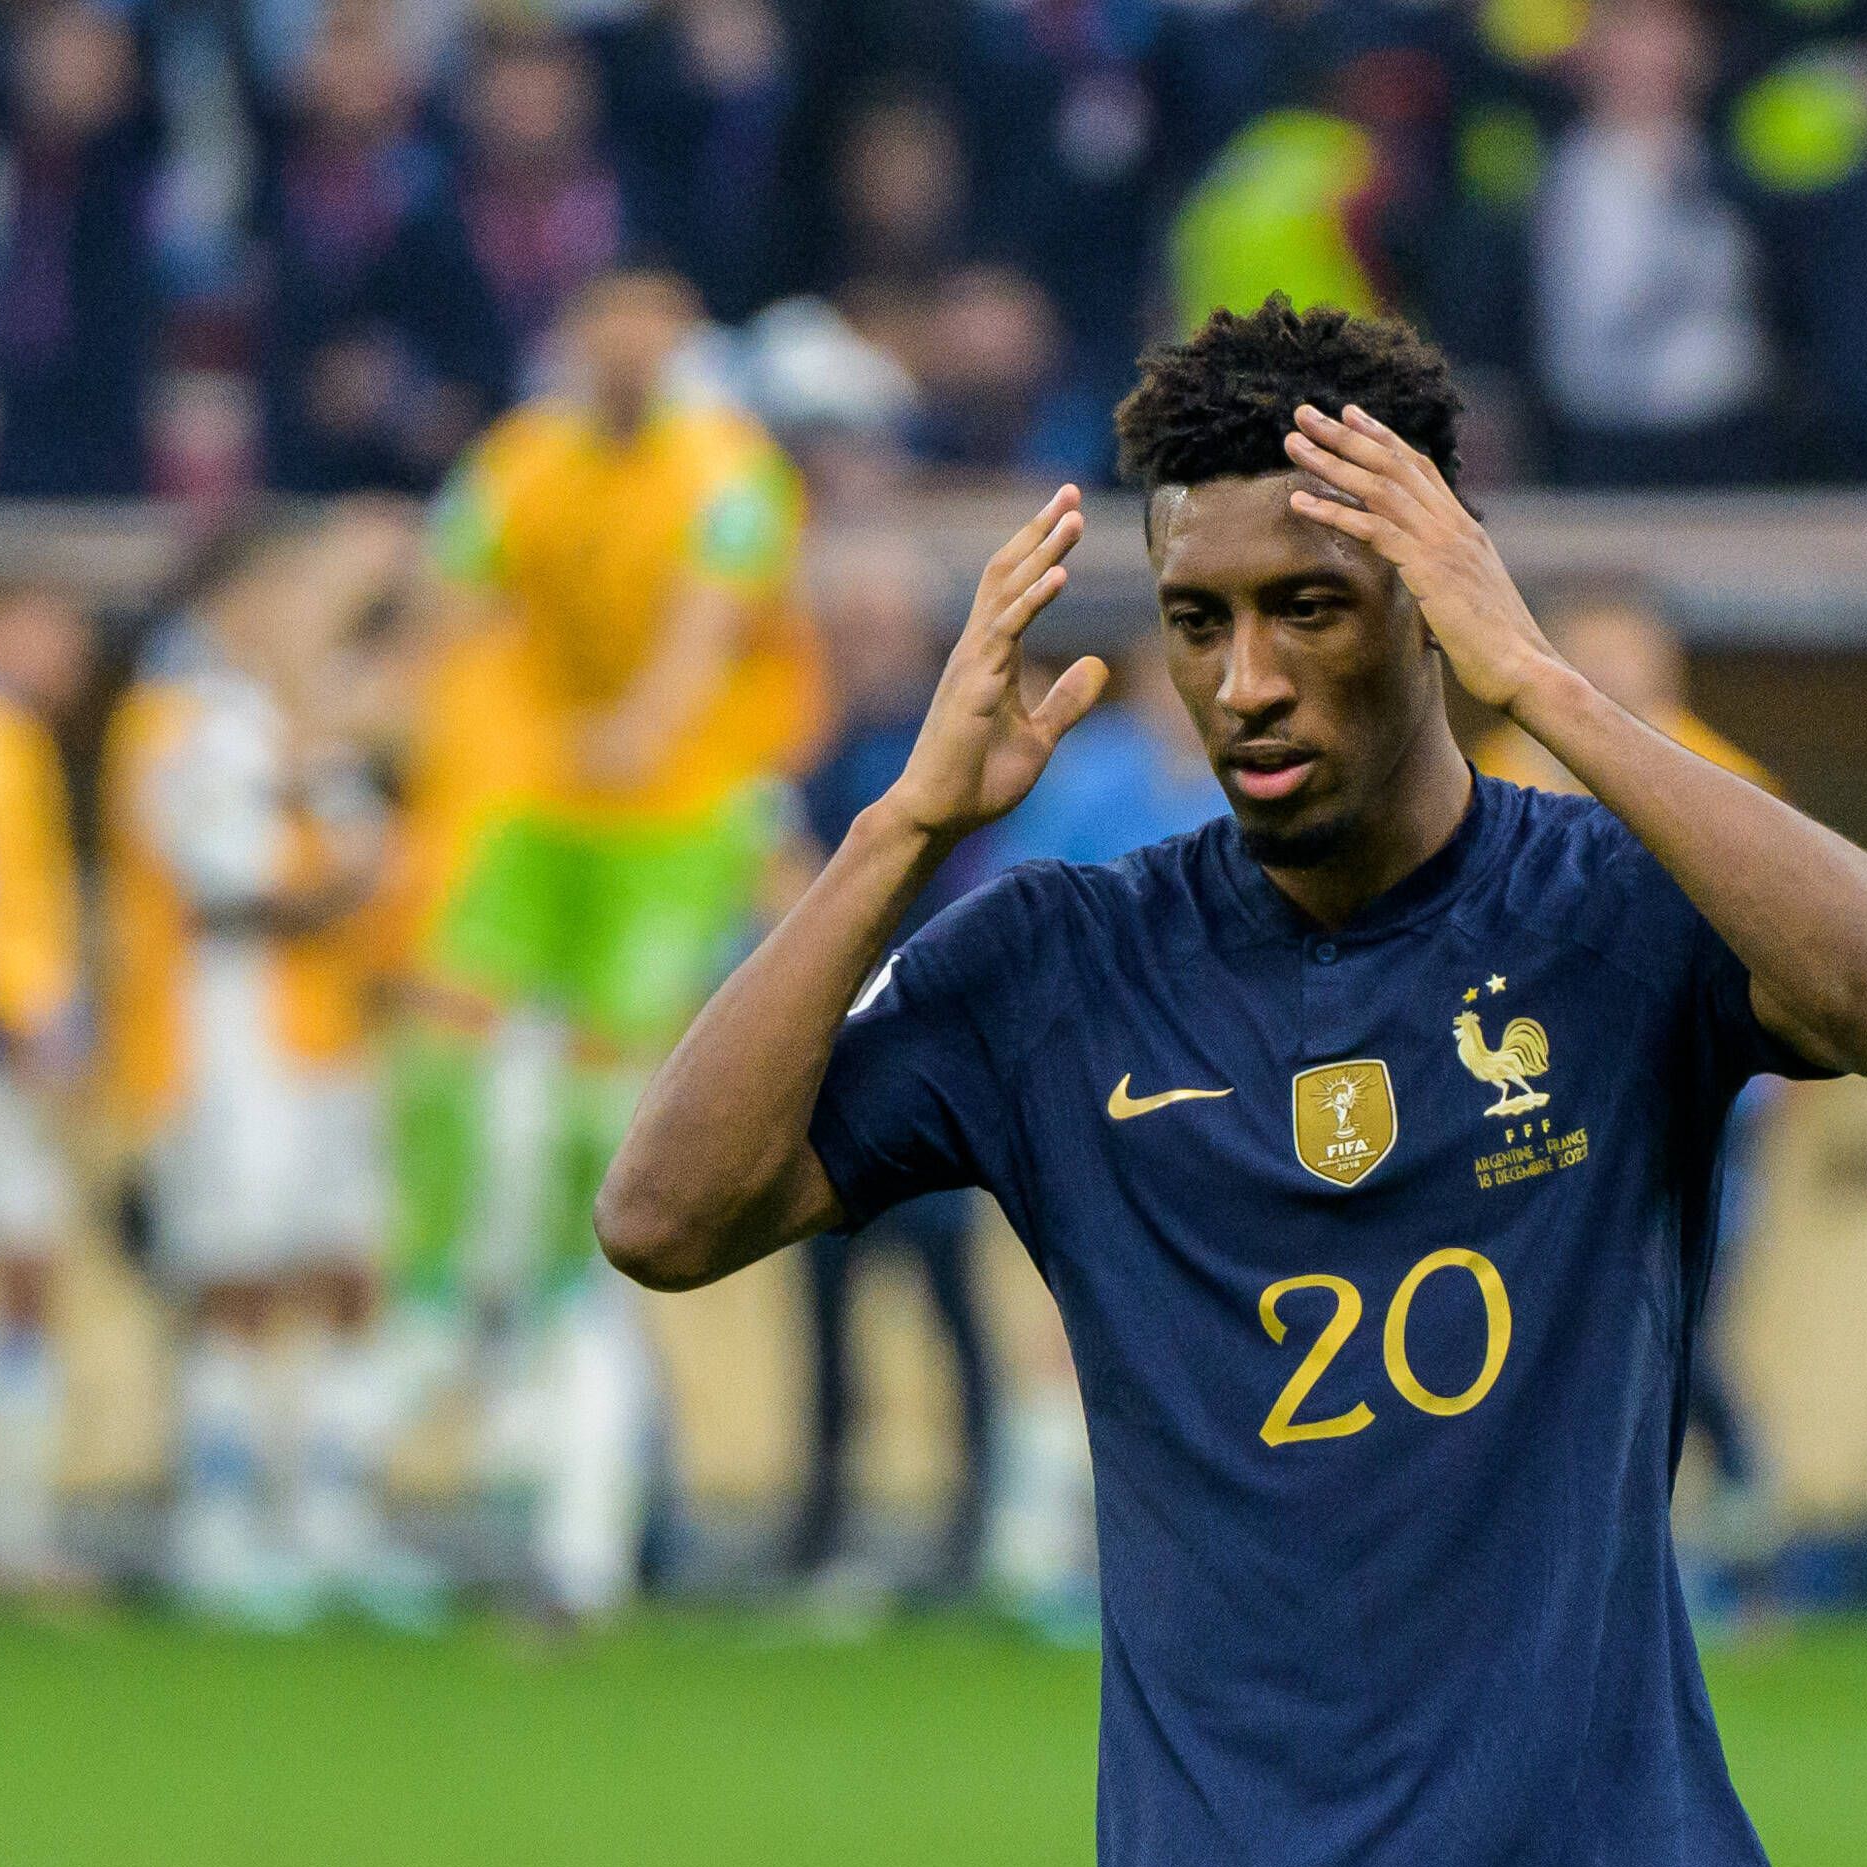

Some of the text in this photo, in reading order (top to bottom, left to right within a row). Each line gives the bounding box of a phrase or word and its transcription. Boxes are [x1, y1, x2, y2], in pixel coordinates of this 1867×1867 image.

[1326, 1139, 1369, 1159] FIFA
[1475, 1145, 1534, 1174] ARGENTINE
[1546, 1127, 1589, 1155] FRANCE
[1478, 1174, 1493, 1190] 18
[1258, 1247, 1512, 1448] 20
